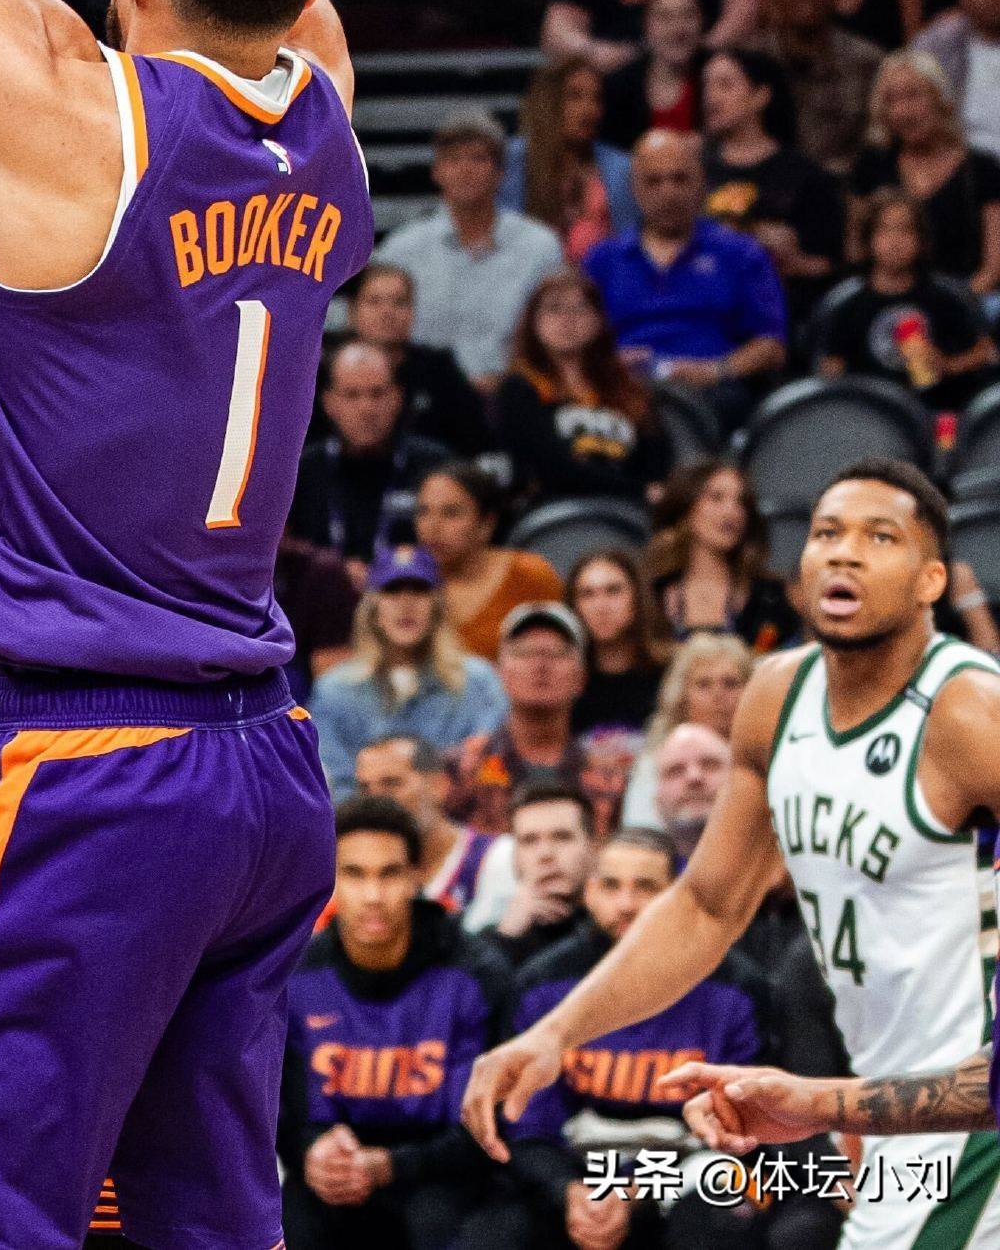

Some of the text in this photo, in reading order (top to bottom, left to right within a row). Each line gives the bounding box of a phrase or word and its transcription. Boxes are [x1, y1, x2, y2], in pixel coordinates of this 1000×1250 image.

[169, 193, 342, 288] BOOKER
[205, 300, 271, 530] 1
[771, 793, 902, 884] UCKS
